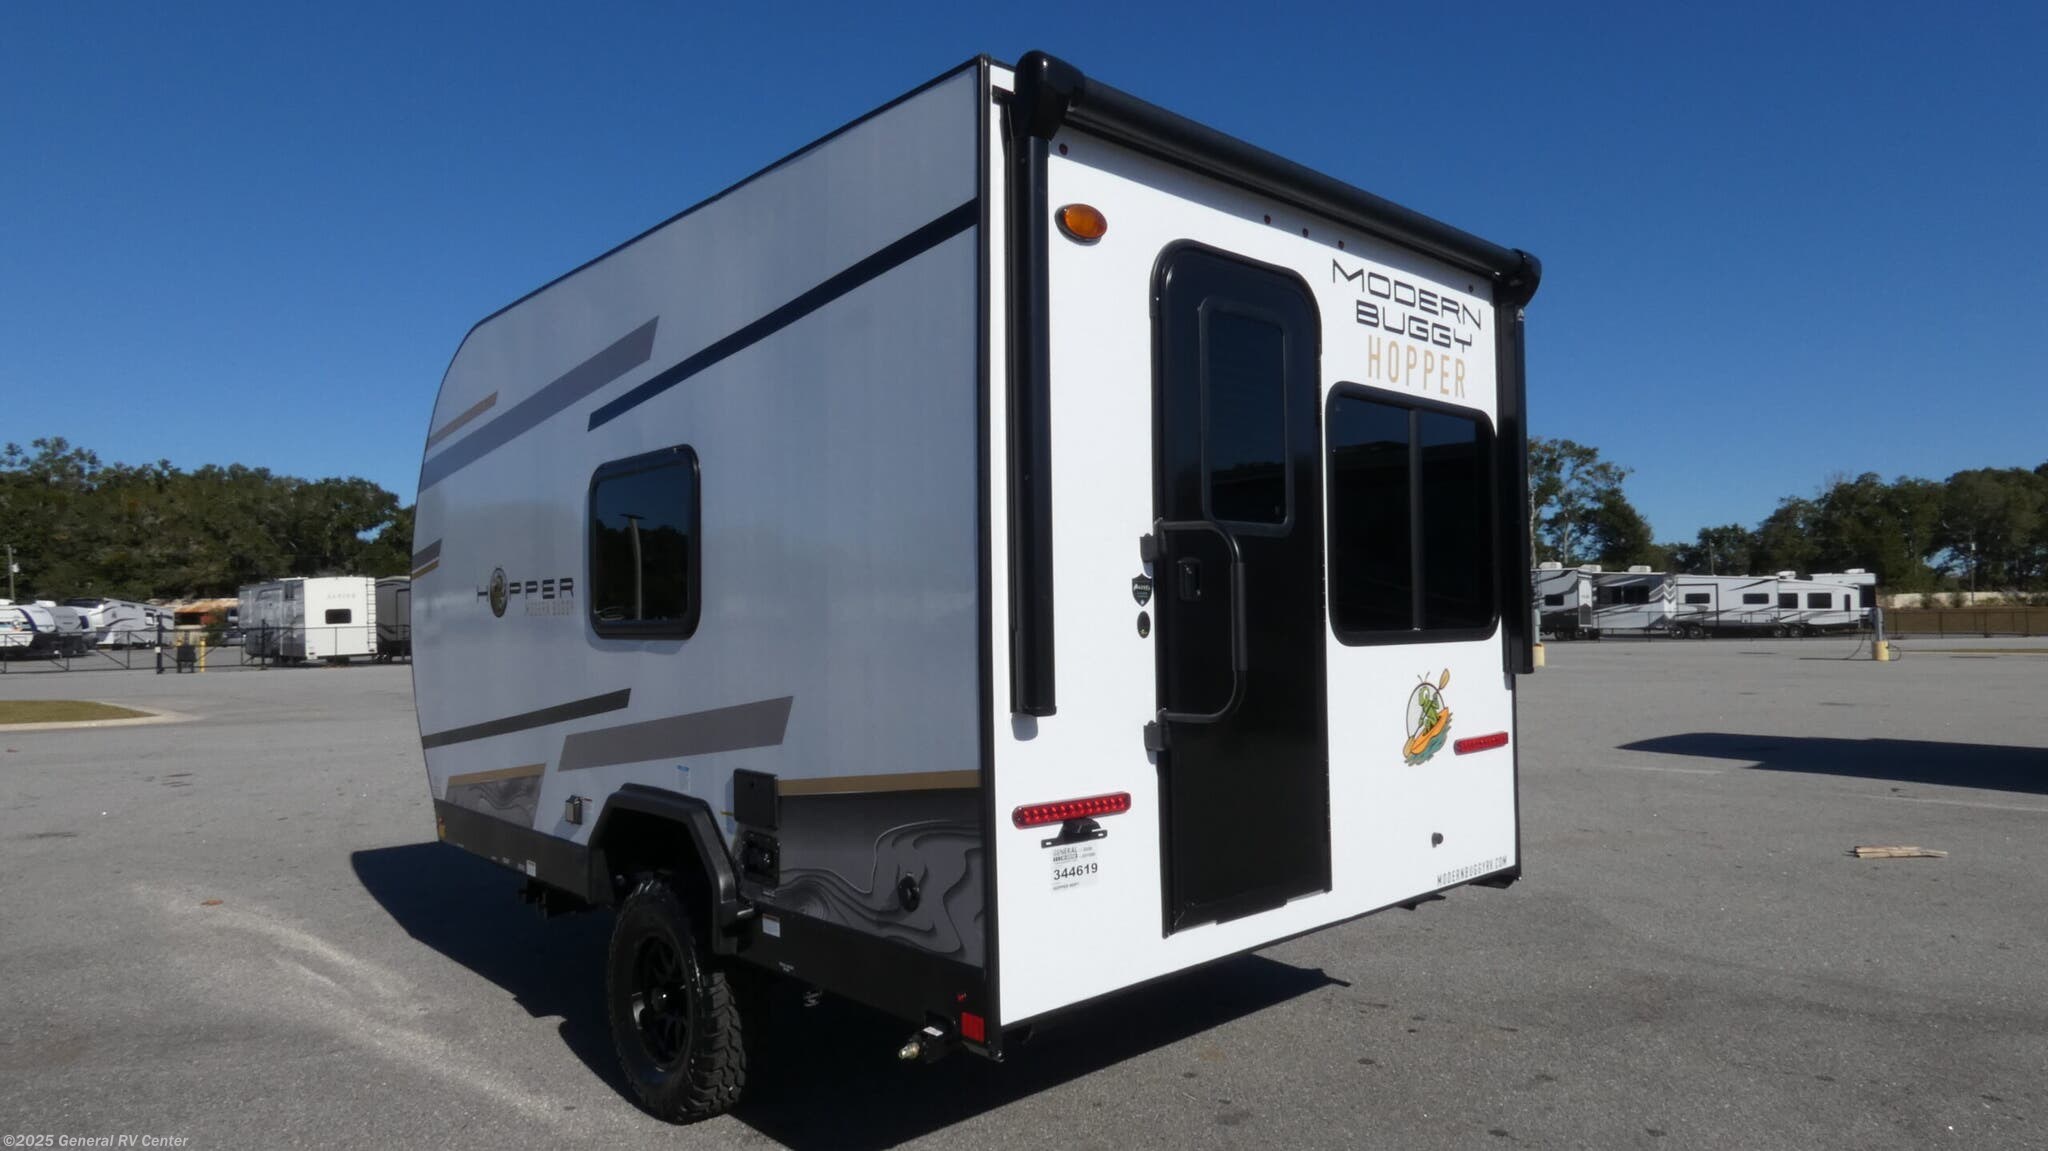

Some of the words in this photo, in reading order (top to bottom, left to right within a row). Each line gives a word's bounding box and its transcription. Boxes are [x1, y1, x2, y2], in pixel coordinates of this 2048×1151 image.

[1332, 258, 1482, 330] MODERN
[1356, 299, 1472, 353] BUGGY
[1368, 334, 1466, 398] HOPPER
[1053, 862, 1098, 881] 344619
